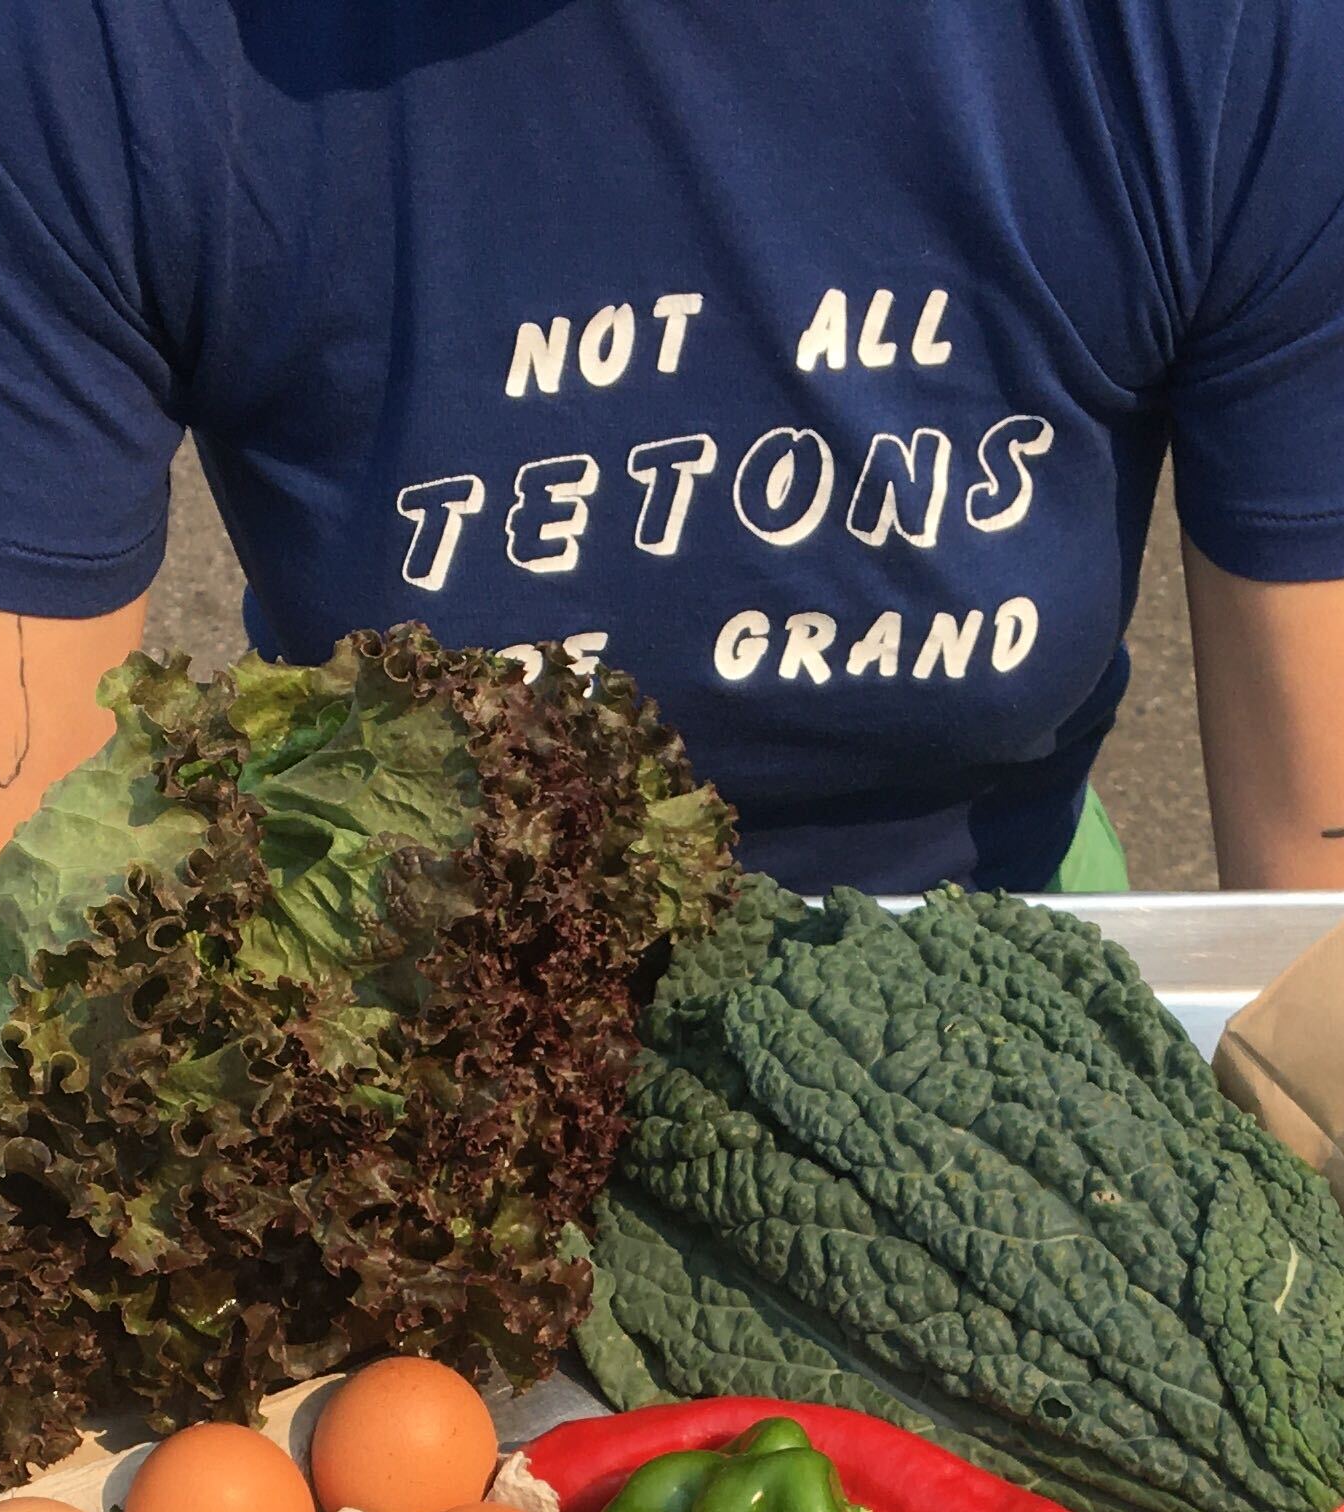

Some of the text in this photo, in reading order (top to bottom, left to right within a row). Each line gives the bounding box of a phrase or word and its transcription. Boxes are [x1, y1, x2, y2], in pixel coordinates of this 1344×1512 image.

[505, 287, 953, 398] NOT ALL
[396, 414, 1056, 592] TETONS
[713, 596, 1040, 685] GRAND
